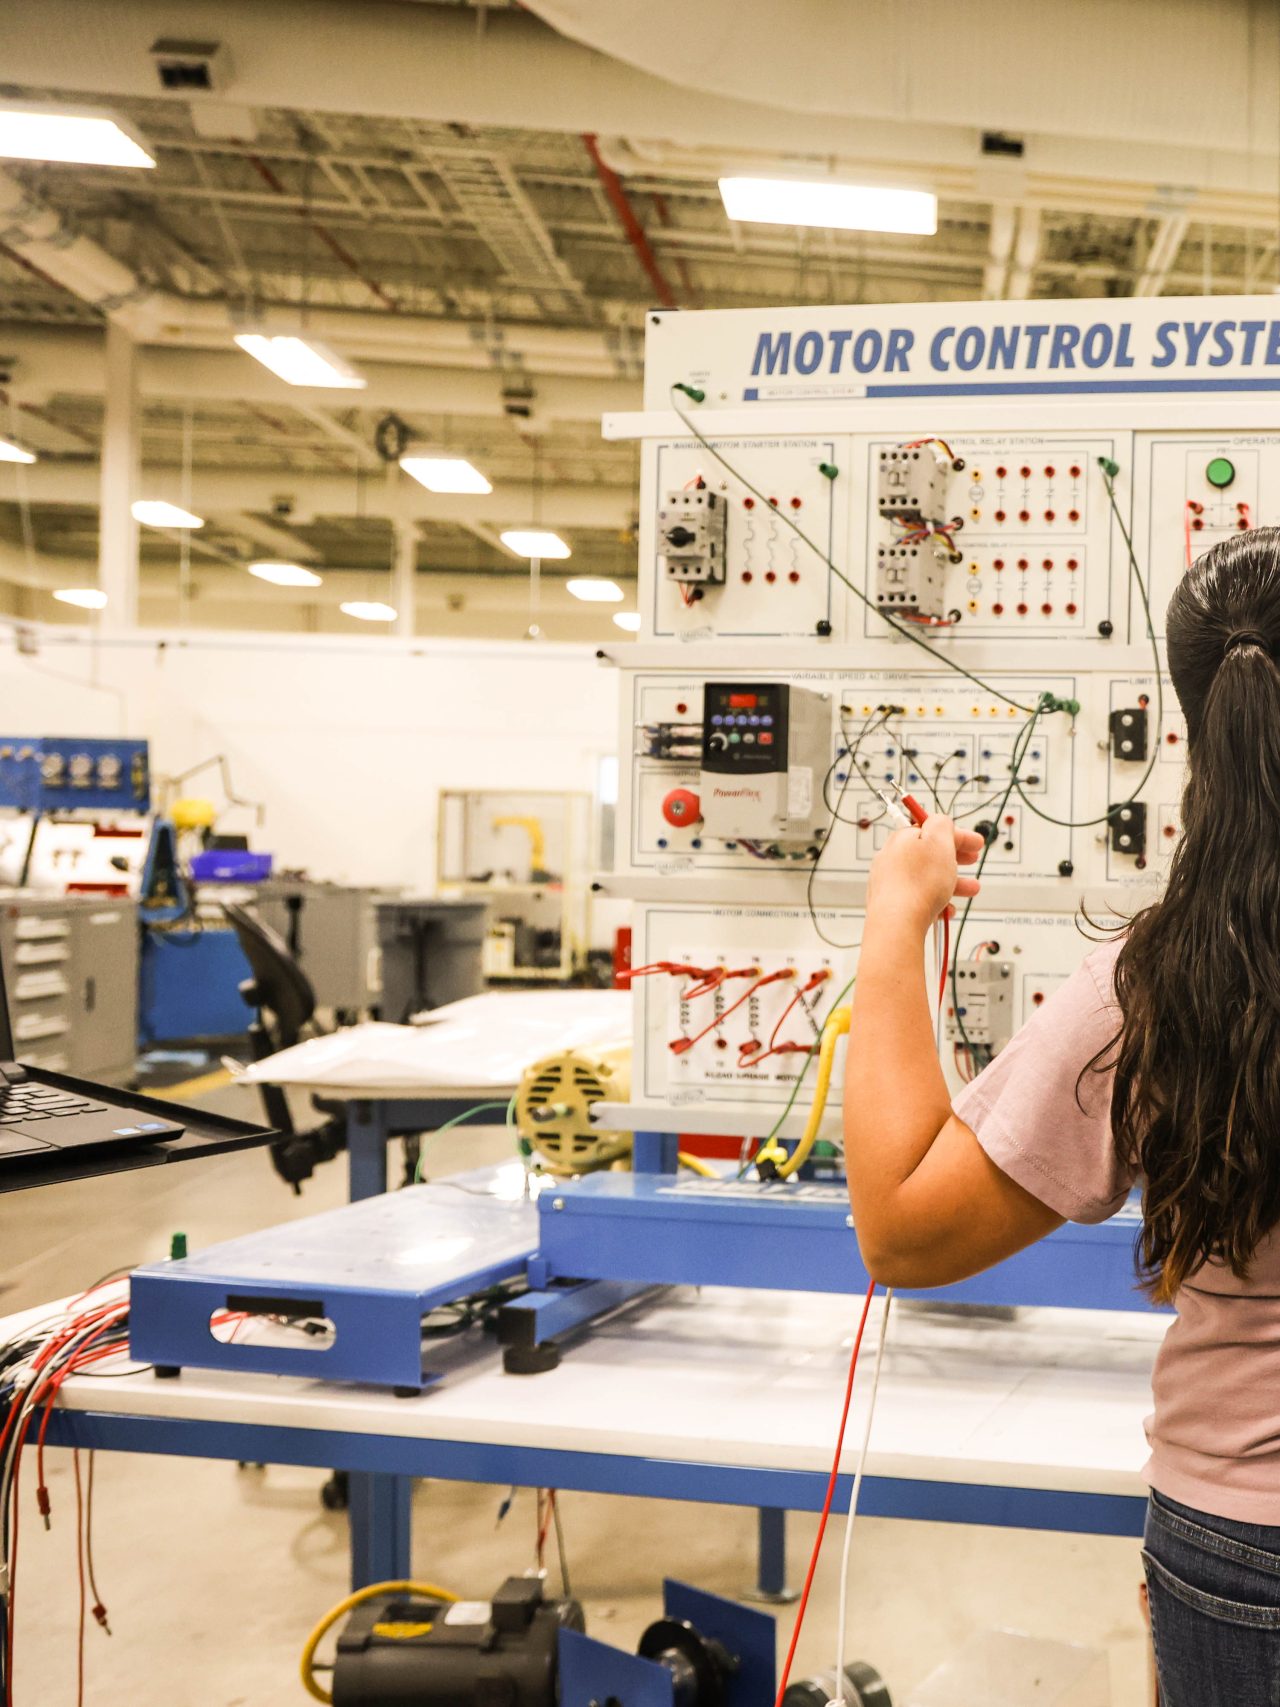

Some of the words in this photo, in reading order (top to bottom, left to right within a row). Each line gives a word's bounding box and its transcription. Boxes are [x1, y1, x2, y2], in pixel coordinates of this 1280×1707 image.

[750, 329, 915, 376] MOTOR
[929, 323, 1135, 372] CONTROL
[742, 440, 780, 449] STARTER
[783, 440, 818, 448] STATION
[1009, 436, 1044, 445] STATION
[791, 672, 835, 681] VARIABLE
[1129, 677, 1153, 686] LIMIT
[745, 910, 800, 919] CONNECTION
[1004, 916, 1055, 926] OVERLOAD
